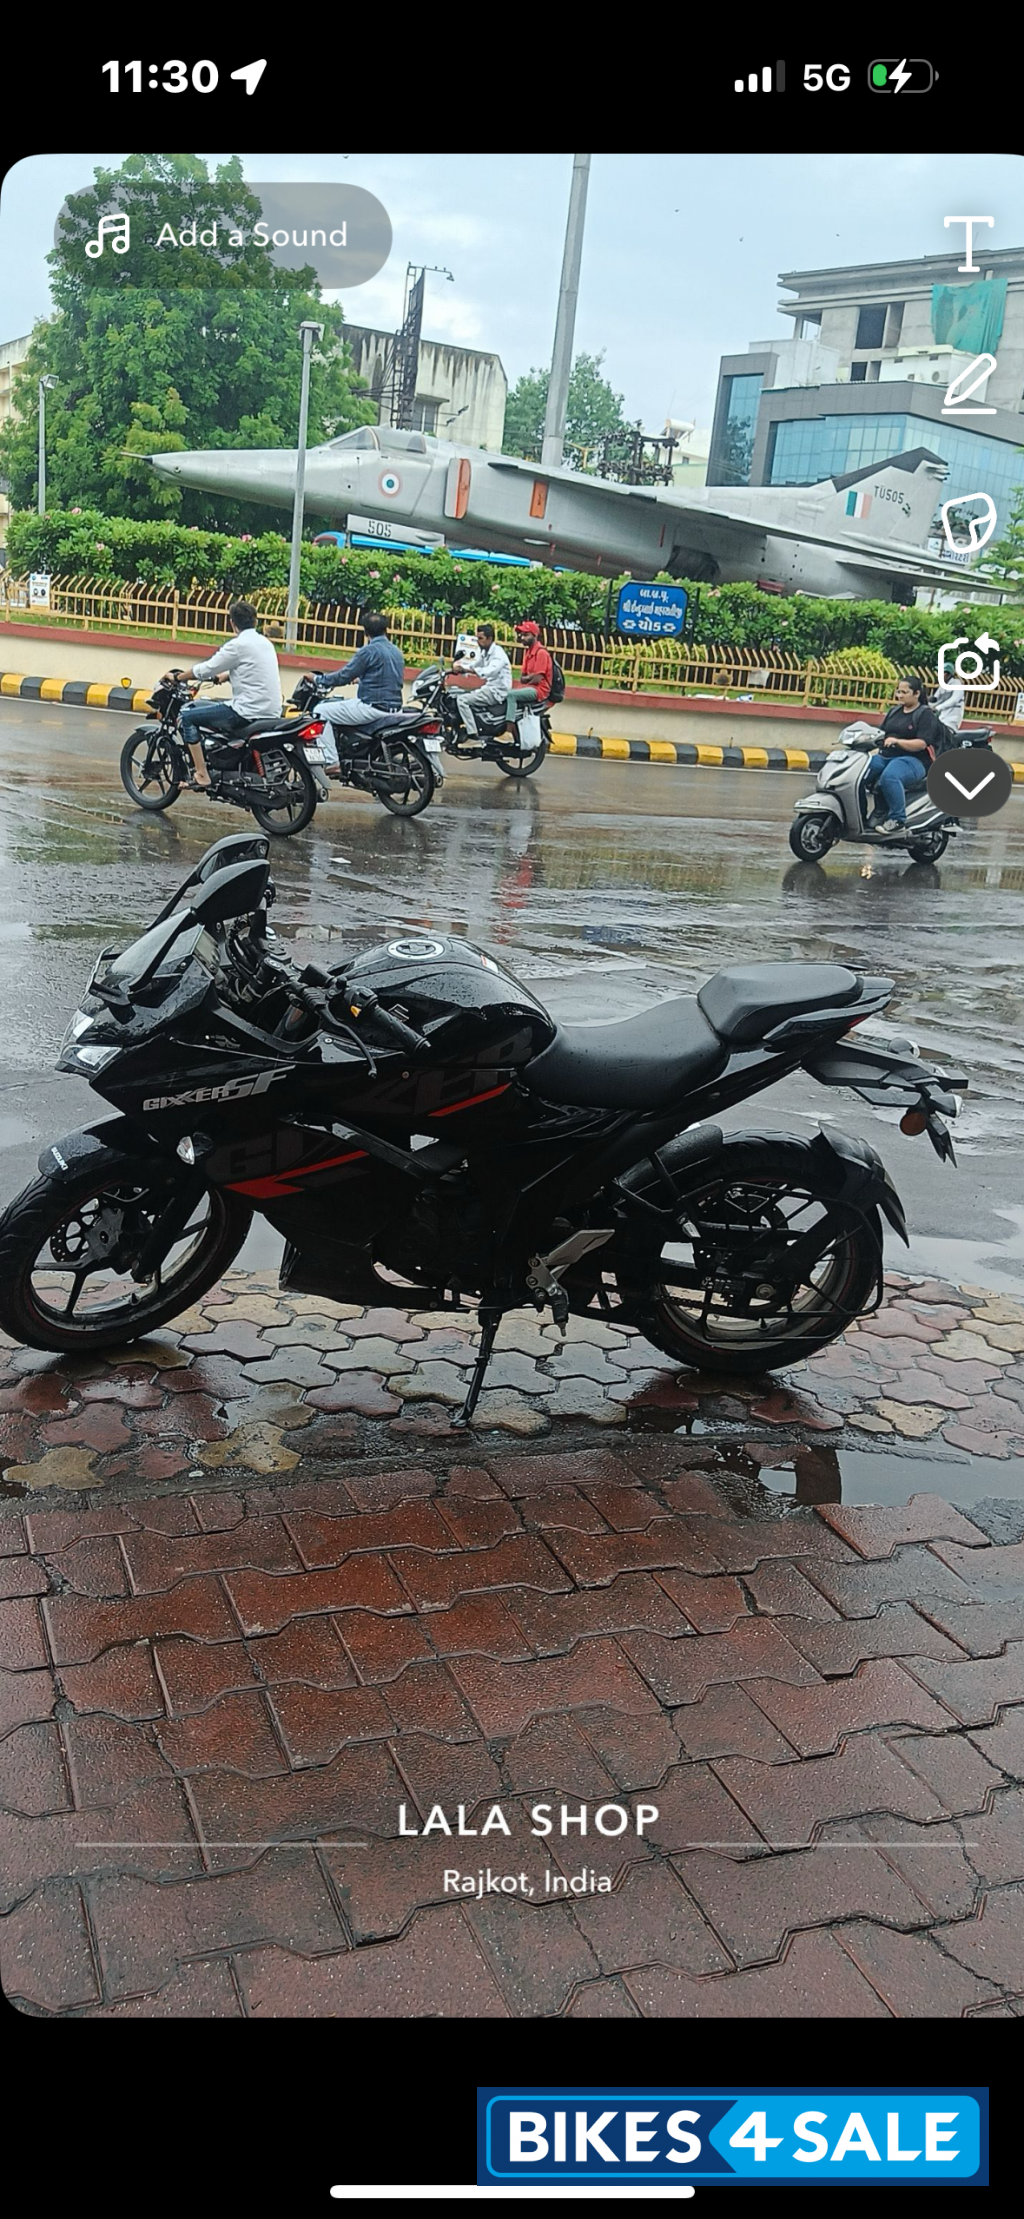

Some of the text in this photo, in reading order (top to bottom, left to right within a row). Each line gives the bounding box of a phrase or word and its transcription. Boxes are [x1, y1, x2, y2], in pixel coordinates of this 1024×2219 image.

[874, 485, 905, 504] TU505
[367, 520, 392, 538] 505
[143, 1065, 296, 1111] GIXXER SF
